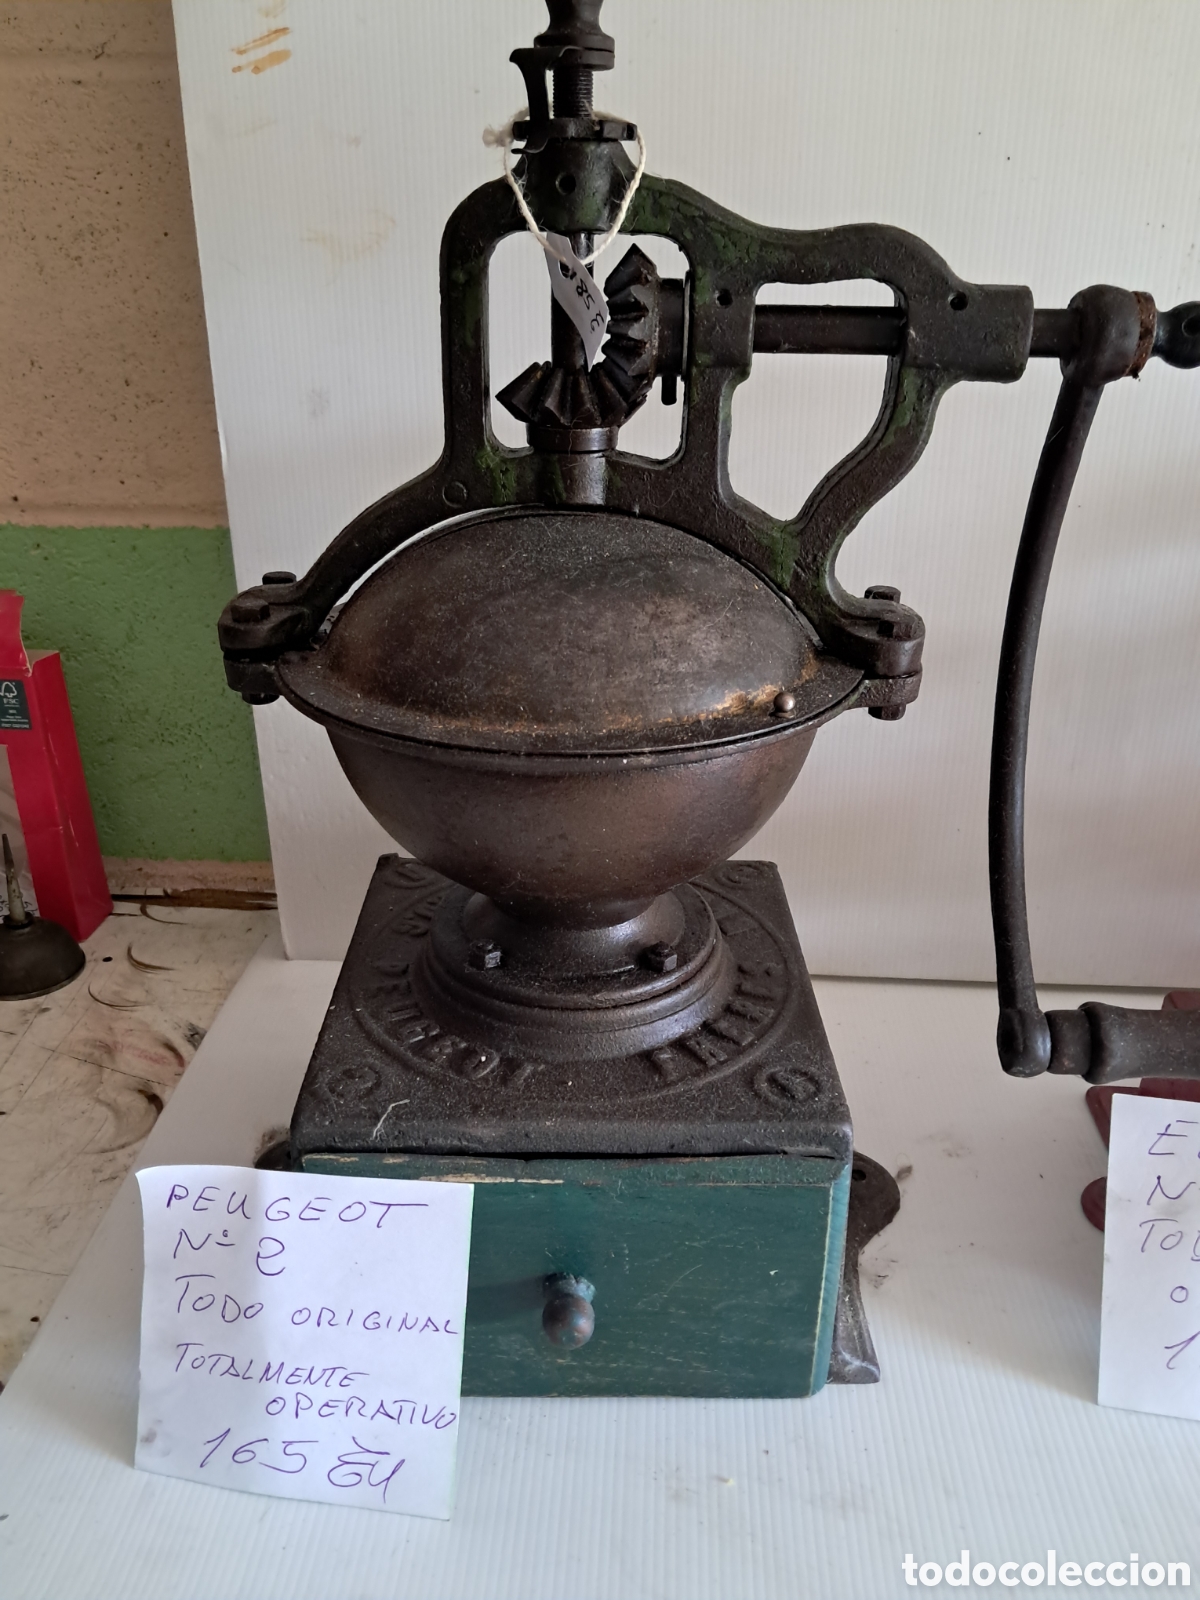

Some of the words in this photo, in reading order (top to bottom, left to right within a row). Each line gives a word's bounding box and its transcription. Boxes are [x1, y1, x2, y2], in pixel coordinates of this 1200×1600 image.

[166, 1184, 429, 1229] PEUGEOT
[175, 1274, 264, 1323] TODO
[291, 1307, 459, 1335] ORIGINAL
[175, 1342, 369, 1388] TOTALMENTE
[265, 1392, 457, 1430] OPERATIVO
[200, 1428, 319, 1474] 165
